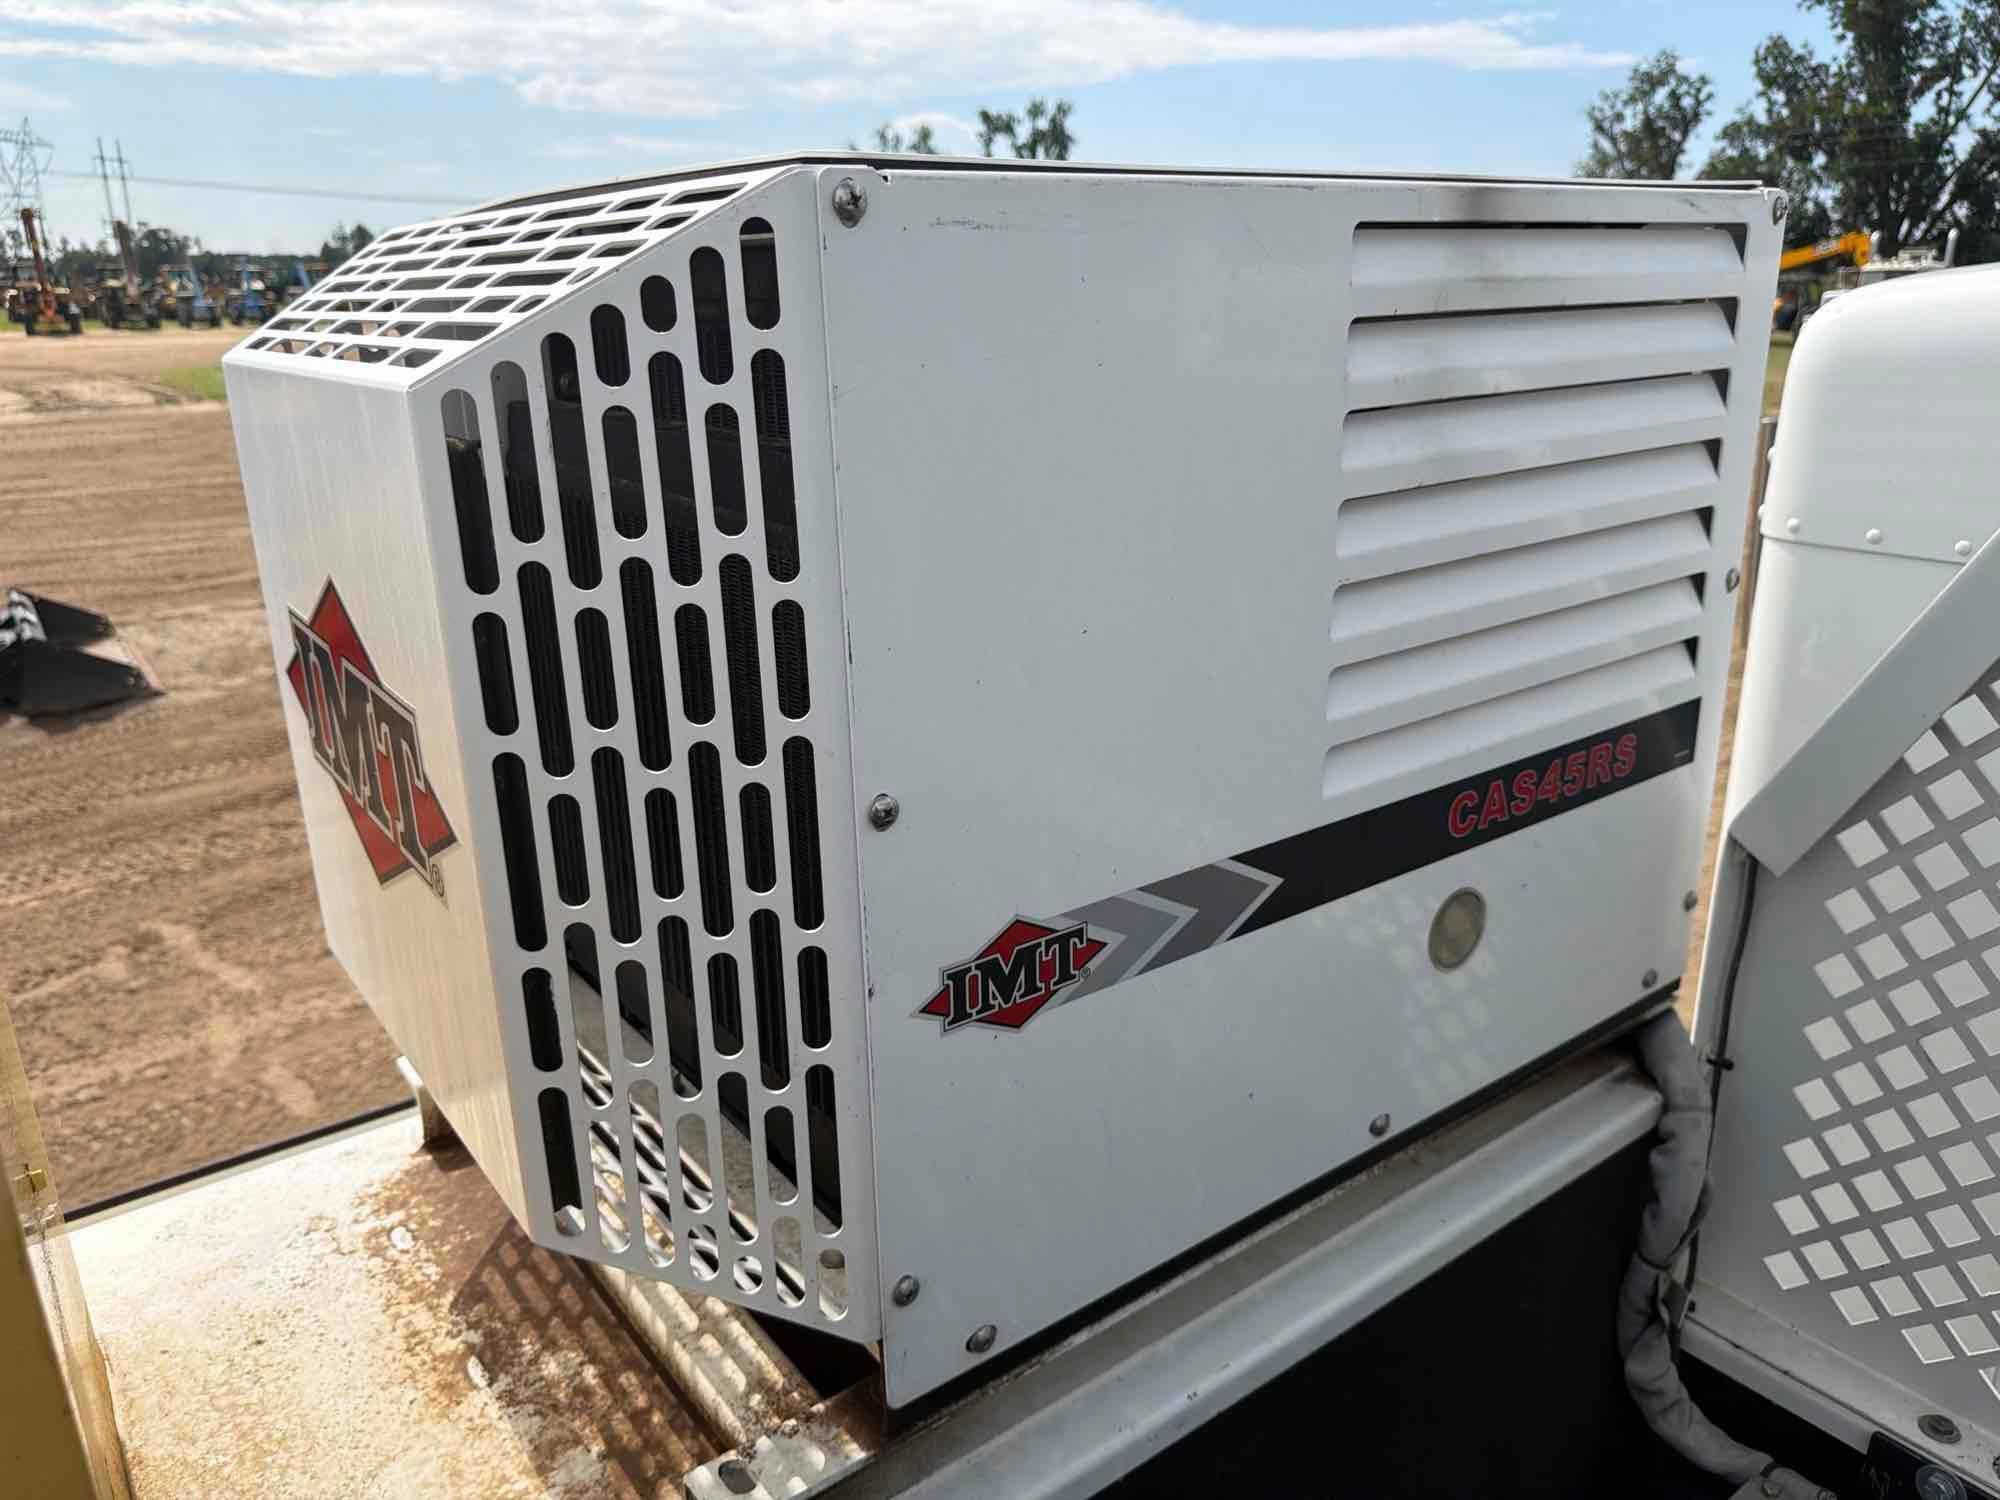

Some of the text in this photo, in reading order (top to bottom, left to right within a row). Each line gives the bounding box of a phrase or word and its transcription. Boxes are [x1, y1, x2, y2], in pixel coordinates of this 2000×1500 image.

[289, 608, 432, 886] IMT
[1447, 734, 1637, 839] CAS45RS
[943, 922, 1088, 1031] IMT
